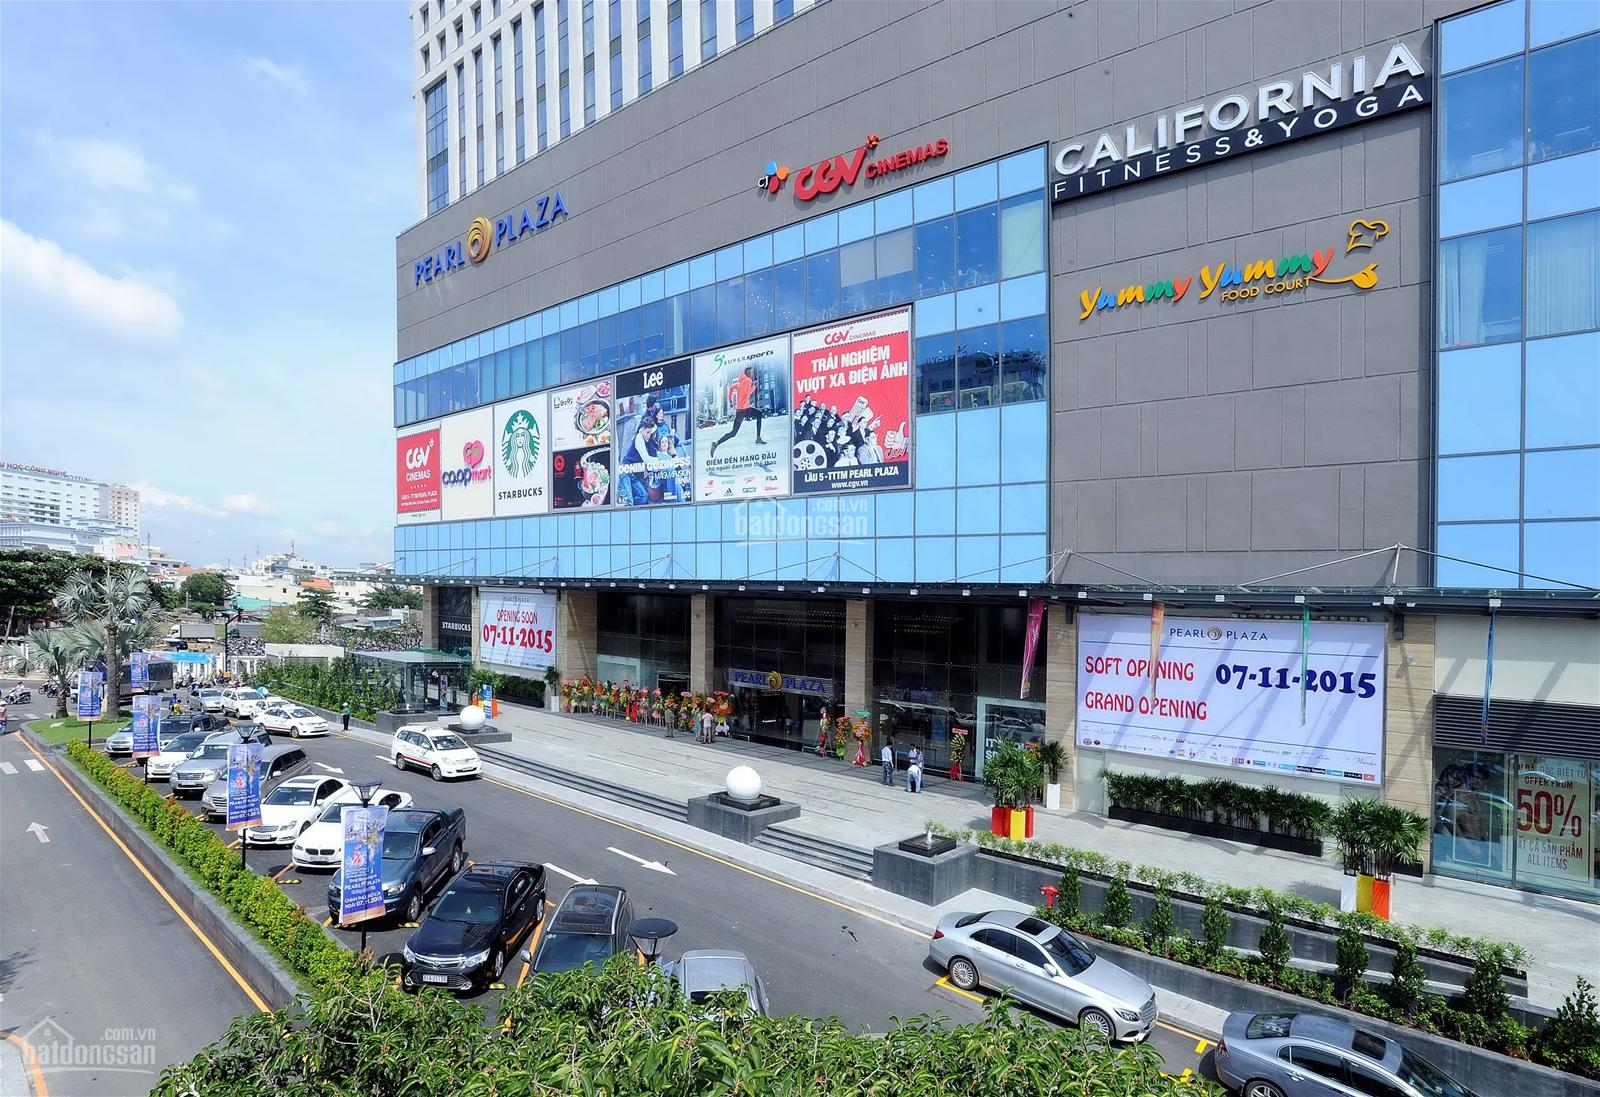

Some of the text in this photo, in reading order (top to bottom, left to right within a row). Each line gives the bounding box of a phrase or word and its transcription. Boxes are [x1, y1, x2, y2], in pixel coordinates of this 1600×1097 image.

[1054, 42, 1425, 176] CALIFORNIA
[758, 137, 949, 201] CJ CGV CINEMAS
[414, 191, 569, 287] PEARL PLAZA
[1221, 276, 1311, 302] FOOD COURT
[824, 330, 876, 346] CGV CINEMAS
[811, 345, 890, 373] TRẢI NGHIỆM
[643, 371, 664, 389] Lee
[796, 358, 908, 394] VƯỢT XA ĐIỆN ẢNH
[406, 446, 430, 470] CGV
[405, 470, 431, 482] CINEMAS
[850, 468, 873, 479] PEARL
[875, 466, 899, 477] PLAZA
[498, 487, 543, 501] STARBUCKS
[831, 480, 869, 490] www.cgv.vn
[442, 621, 472, 632] STARBUCKS
[497, 609, 538, 625] OPENING SOON
[483, 624, 553, 654] 07-11-2015
[1169, 627, 1268, 641] PEARL PLAZA
[1085, 656, 1122, 675] SOFT
[734, 671, 826, 693] PEARL PLAZA
[1215, 663, 1377, 699] 07-11-2015
[1085, 691, 1207, 721] GRAND OPENING
[1524, 776, 1549, 787] OFFER
[1517, 788, 1582, 839] 50%
[1529, 837, 1540, 852] CẢ
[1542, 839, 1557, 855] SẢN
[1527, 853, 1568, 871] ALL ITEMS
